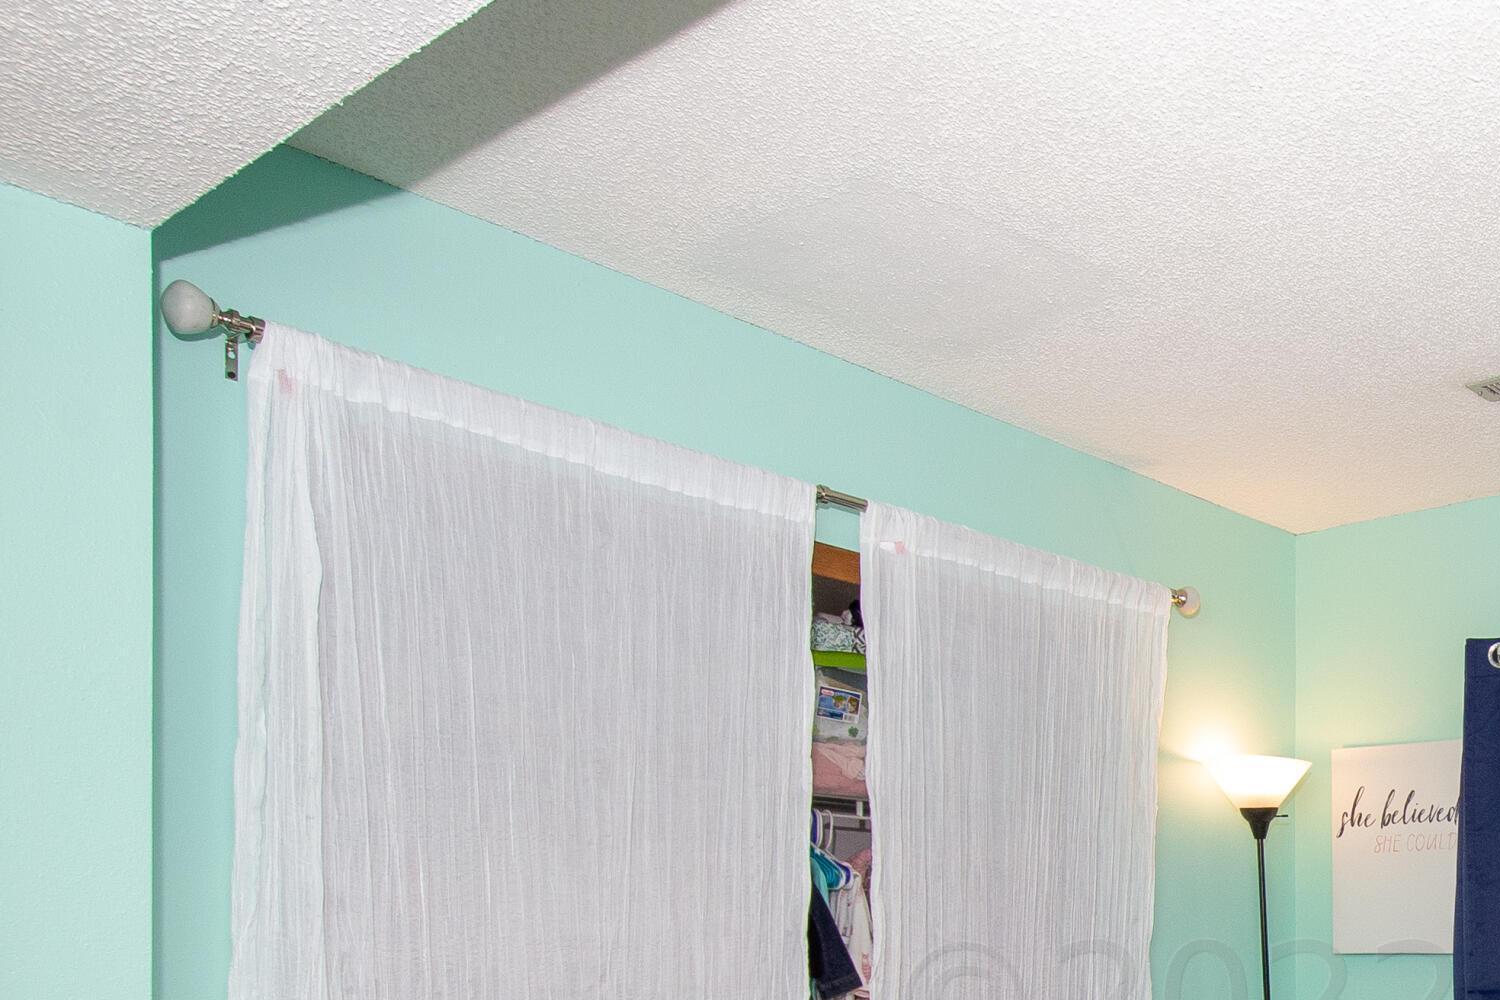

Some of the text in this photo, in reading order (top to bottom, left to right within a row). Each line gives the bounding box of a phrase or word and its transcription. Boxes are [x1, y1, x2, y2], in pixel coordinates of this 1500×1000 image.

[1336, 785, 1461, 840] she believed
[1374, 834, 1401, 854] SHE
